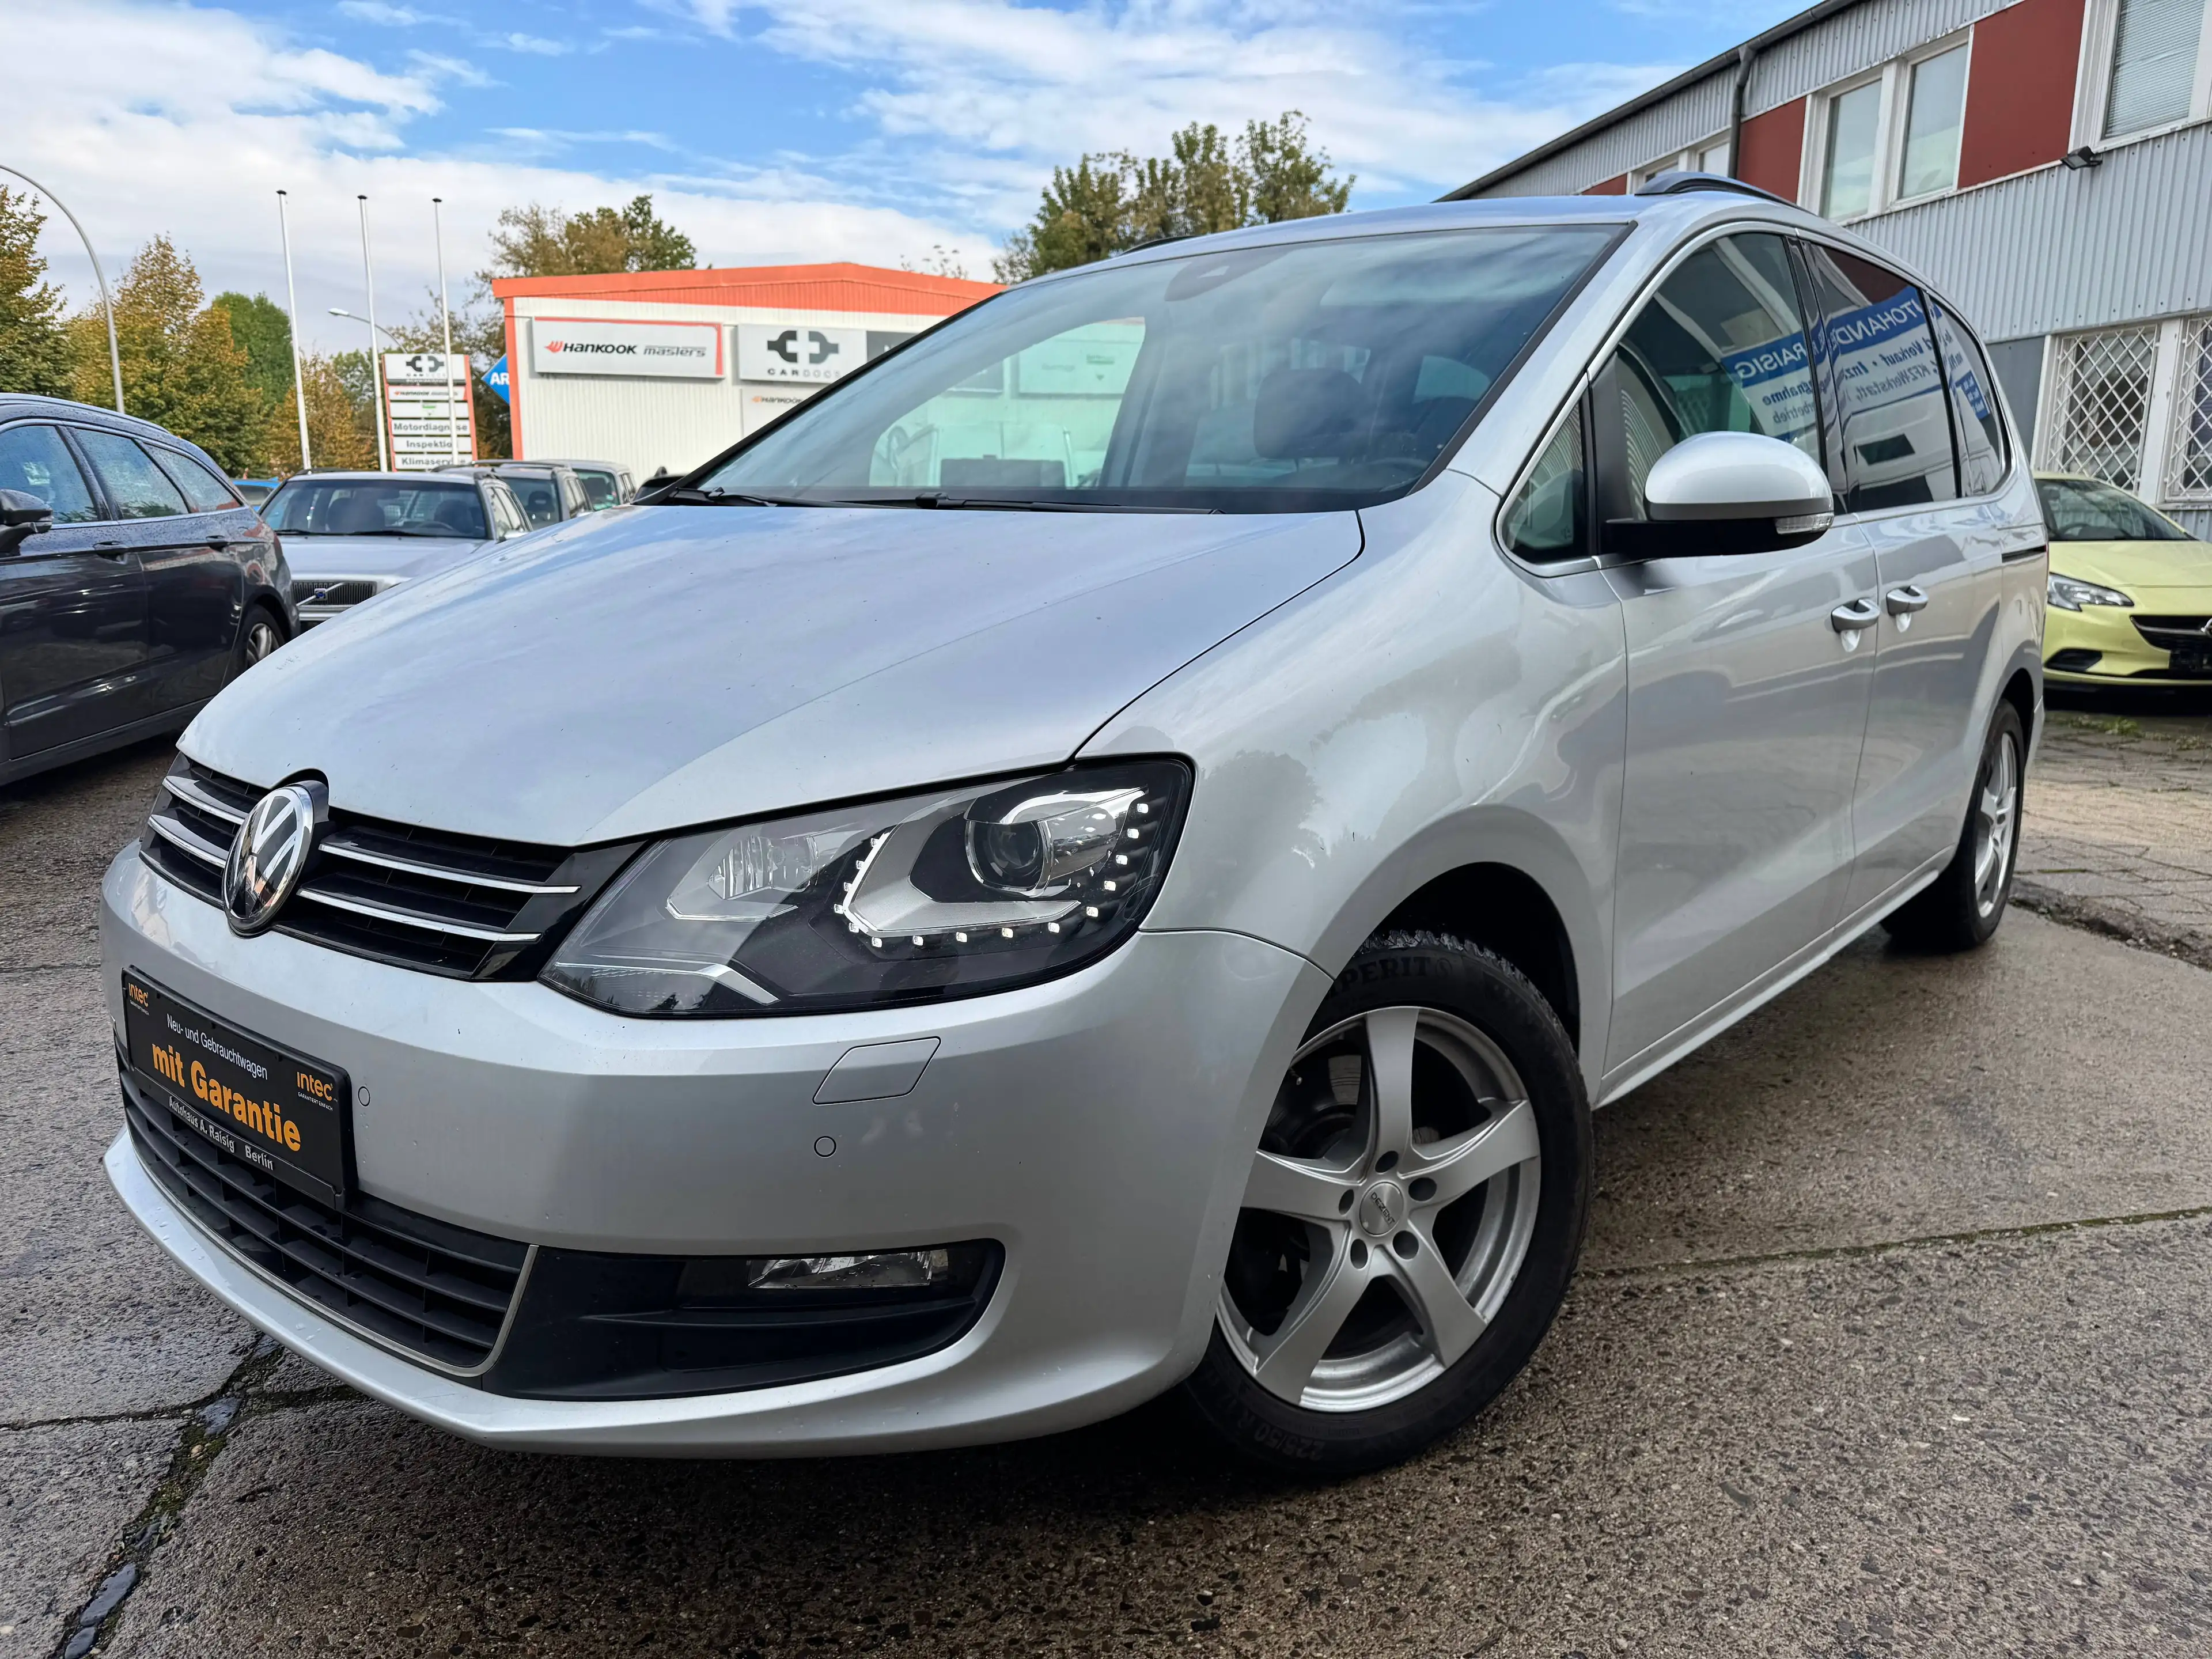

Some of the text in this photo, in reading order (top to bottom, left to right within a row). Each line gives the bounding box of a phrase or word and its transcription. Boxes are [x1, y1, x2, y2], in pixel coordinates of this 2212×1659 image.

[393, 423, 468, 432] Motordiagnse
[406, 440, 453, 449] Inspektio
[1332, 956, 1431, 995] PERIT
[166, 1013, 268, 1080] Neu- und Gebrauchtwagen
[151, 1043, 301, 1152] mit Garantie
[169, 1096, 198, 1128] Autohaus
[209, 1124, 235, 1153] Raisig
[245, 1145, 274, 1171] Berlin
[1370, 1191, 1395, 1225] DEZENT
